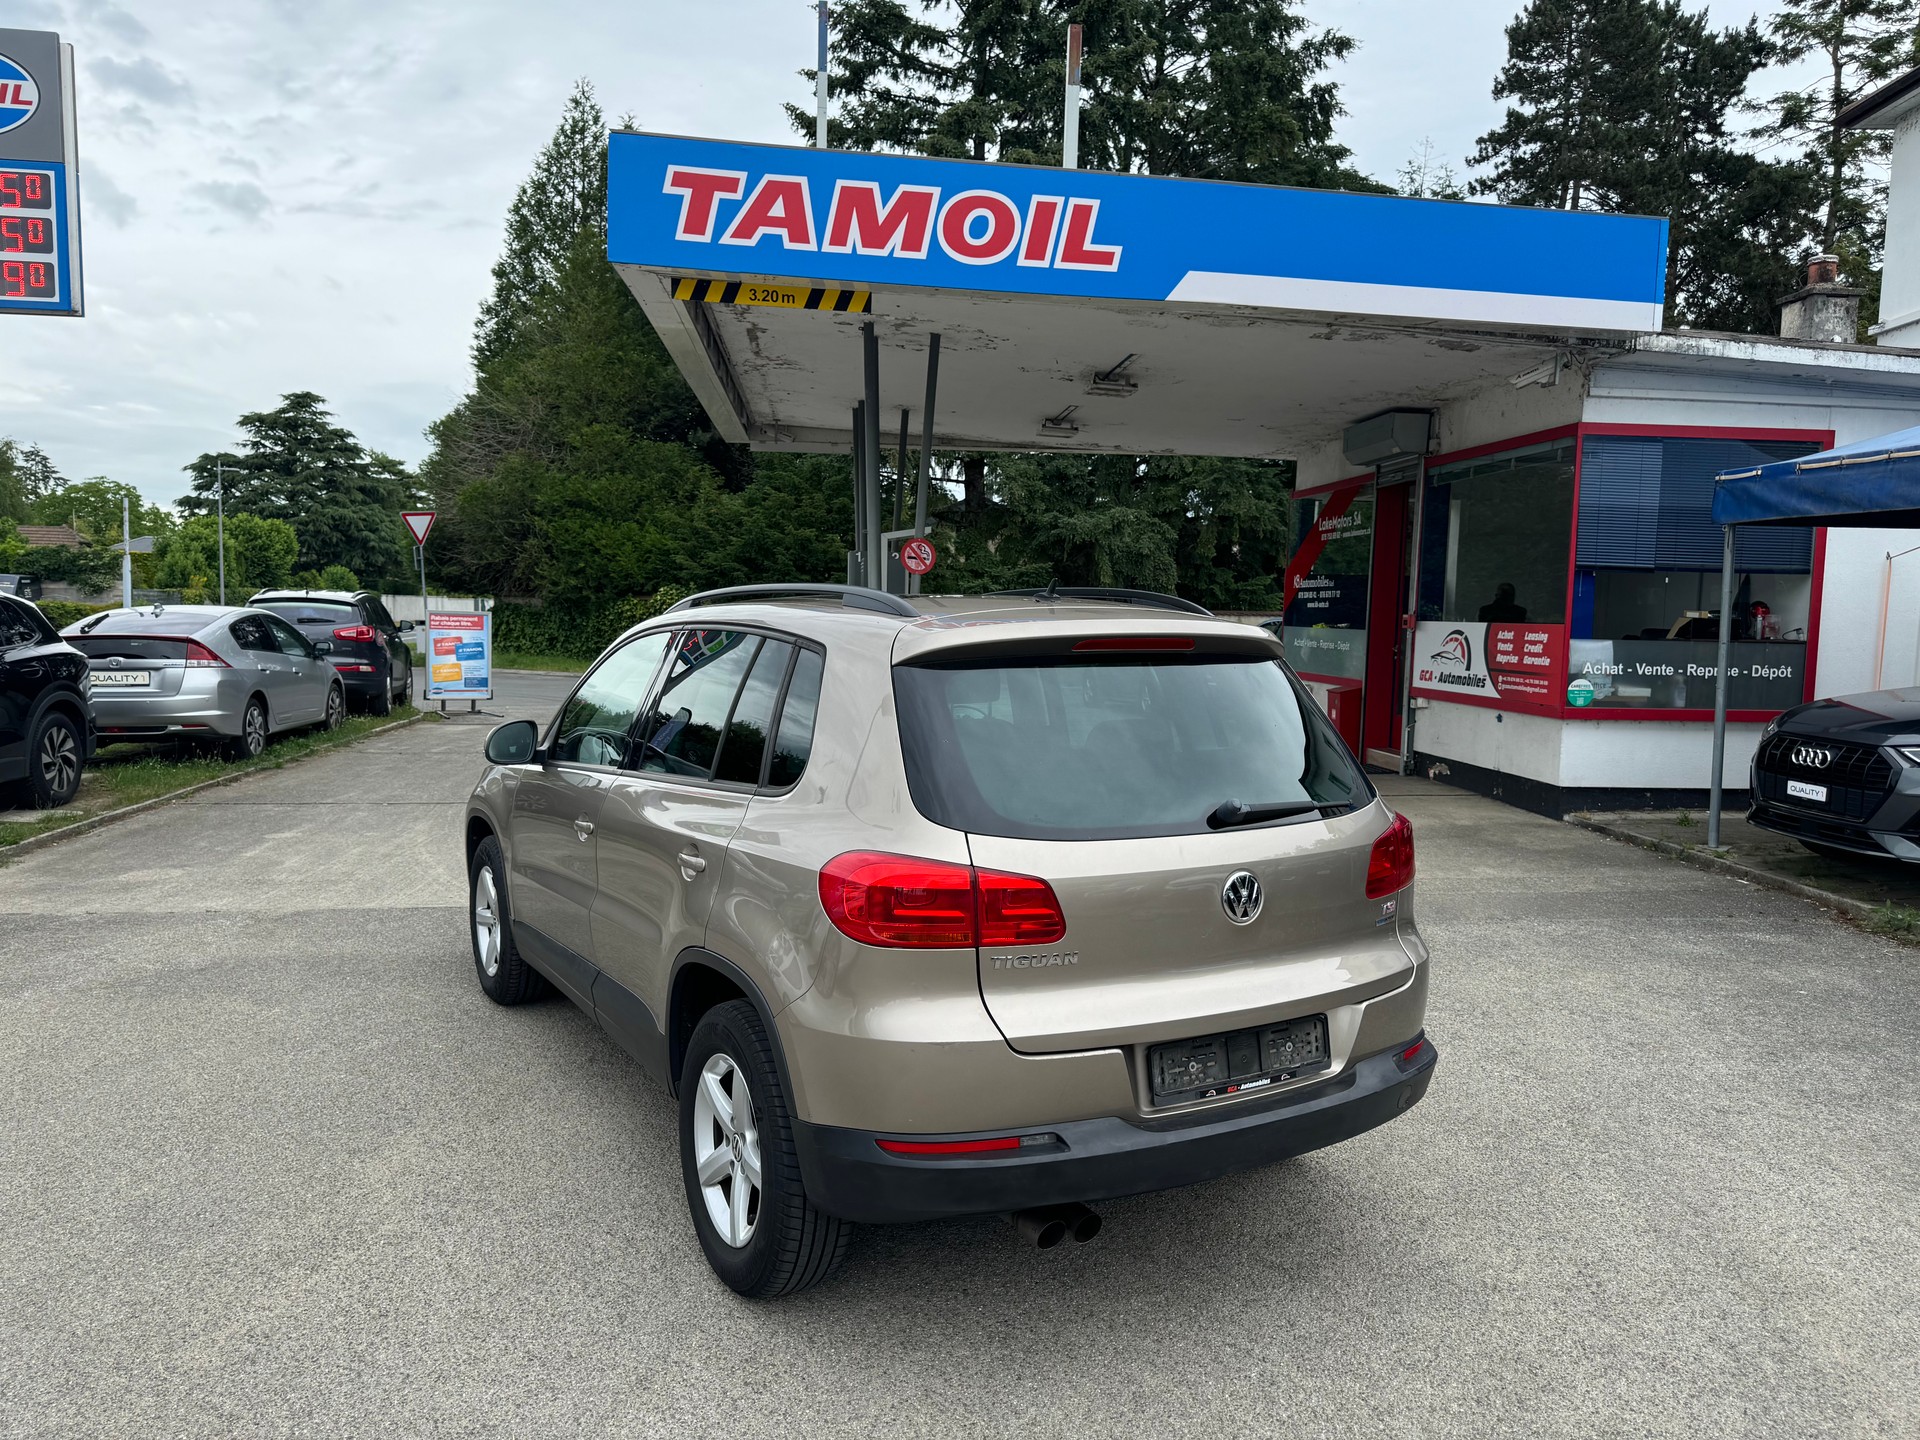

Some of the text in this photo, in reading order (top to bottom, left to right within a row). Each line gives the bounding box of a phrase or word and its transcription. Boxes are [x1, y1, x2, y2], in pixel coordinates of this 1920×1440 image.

[663, 164, 1123, 273] TAMOIL
[749, 288, 795, 304] 3.20 m
[1319, 514, 1352, 531] LakeMotors
[1497, 630, 1514, 640] Achat
[1524, 631, 1549, 644] Leasing
[1497, 642, 1514, 652] Vente
[1496, 653, 1519, 665] Reprise
[1523, 655, 1551, 666] Garantie
[1582, 662, 1624, 675] Achat
[1635, 663, 1674, 676] Vente
[1687, 663, 1739, 680] Reprse
[1752, 664, 1792, 680] Dépôt
[1419, 669, 1433, 682] GCA
[1438, 671, 1487, 689] Automobiles
[1790, 785, 1820, 797] QUALITY
[990, 950, 1080, 970] TIGUAN
[1240, 1078, 1271, 1090] Automobiles
